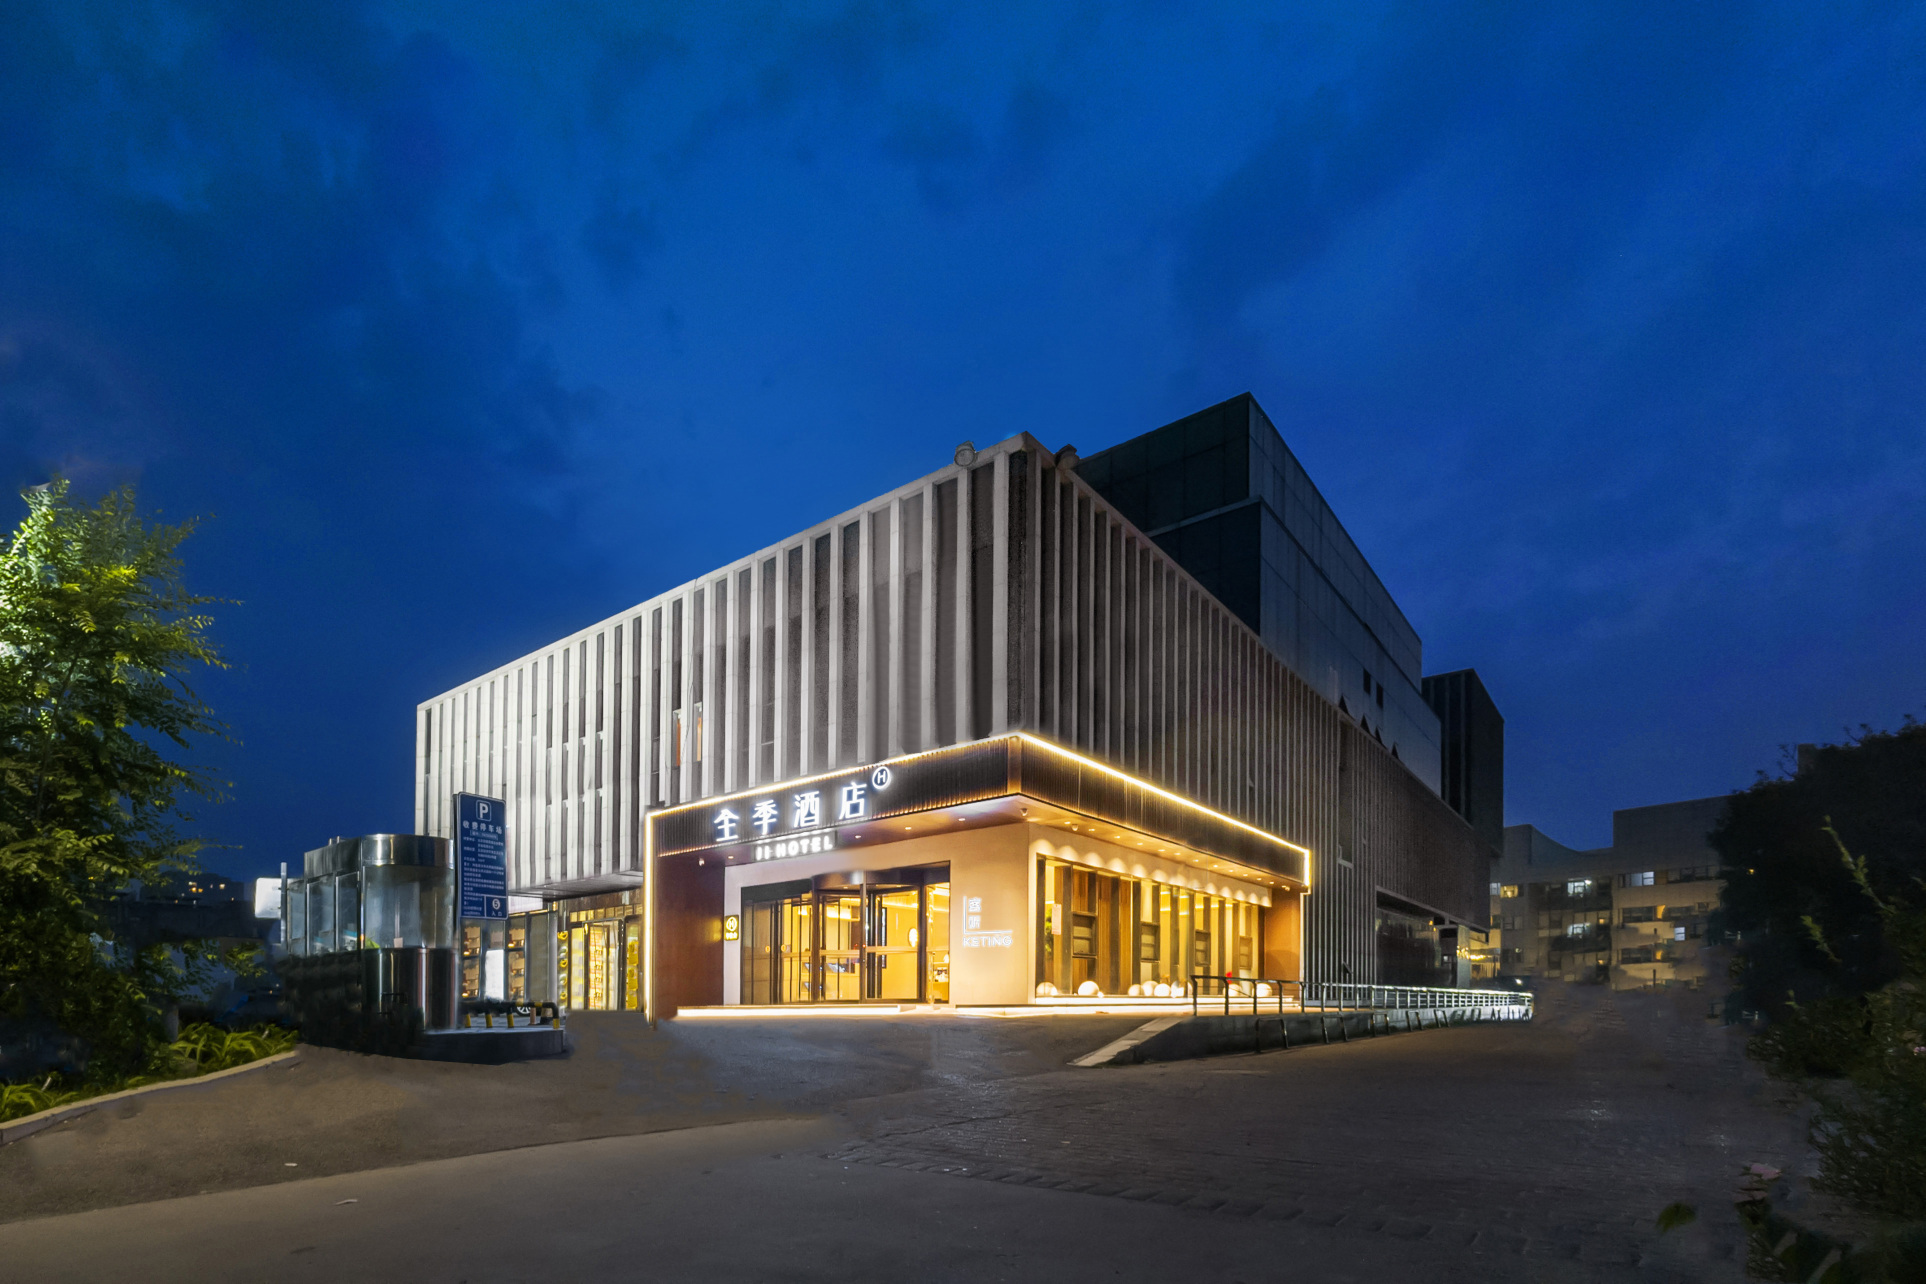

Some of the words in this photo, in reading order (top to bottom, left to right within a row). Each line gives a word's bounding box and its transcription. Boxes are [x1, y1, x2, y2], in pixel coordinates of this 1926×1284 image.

[479, 803, 489, 818] P
[714, 781, 867, 842] 全季酒店
[462, 820, 503, 835] 收费停车场
[775, 835, 833, 858] HOTEL
[963, 935, 1013, 947] KETING
